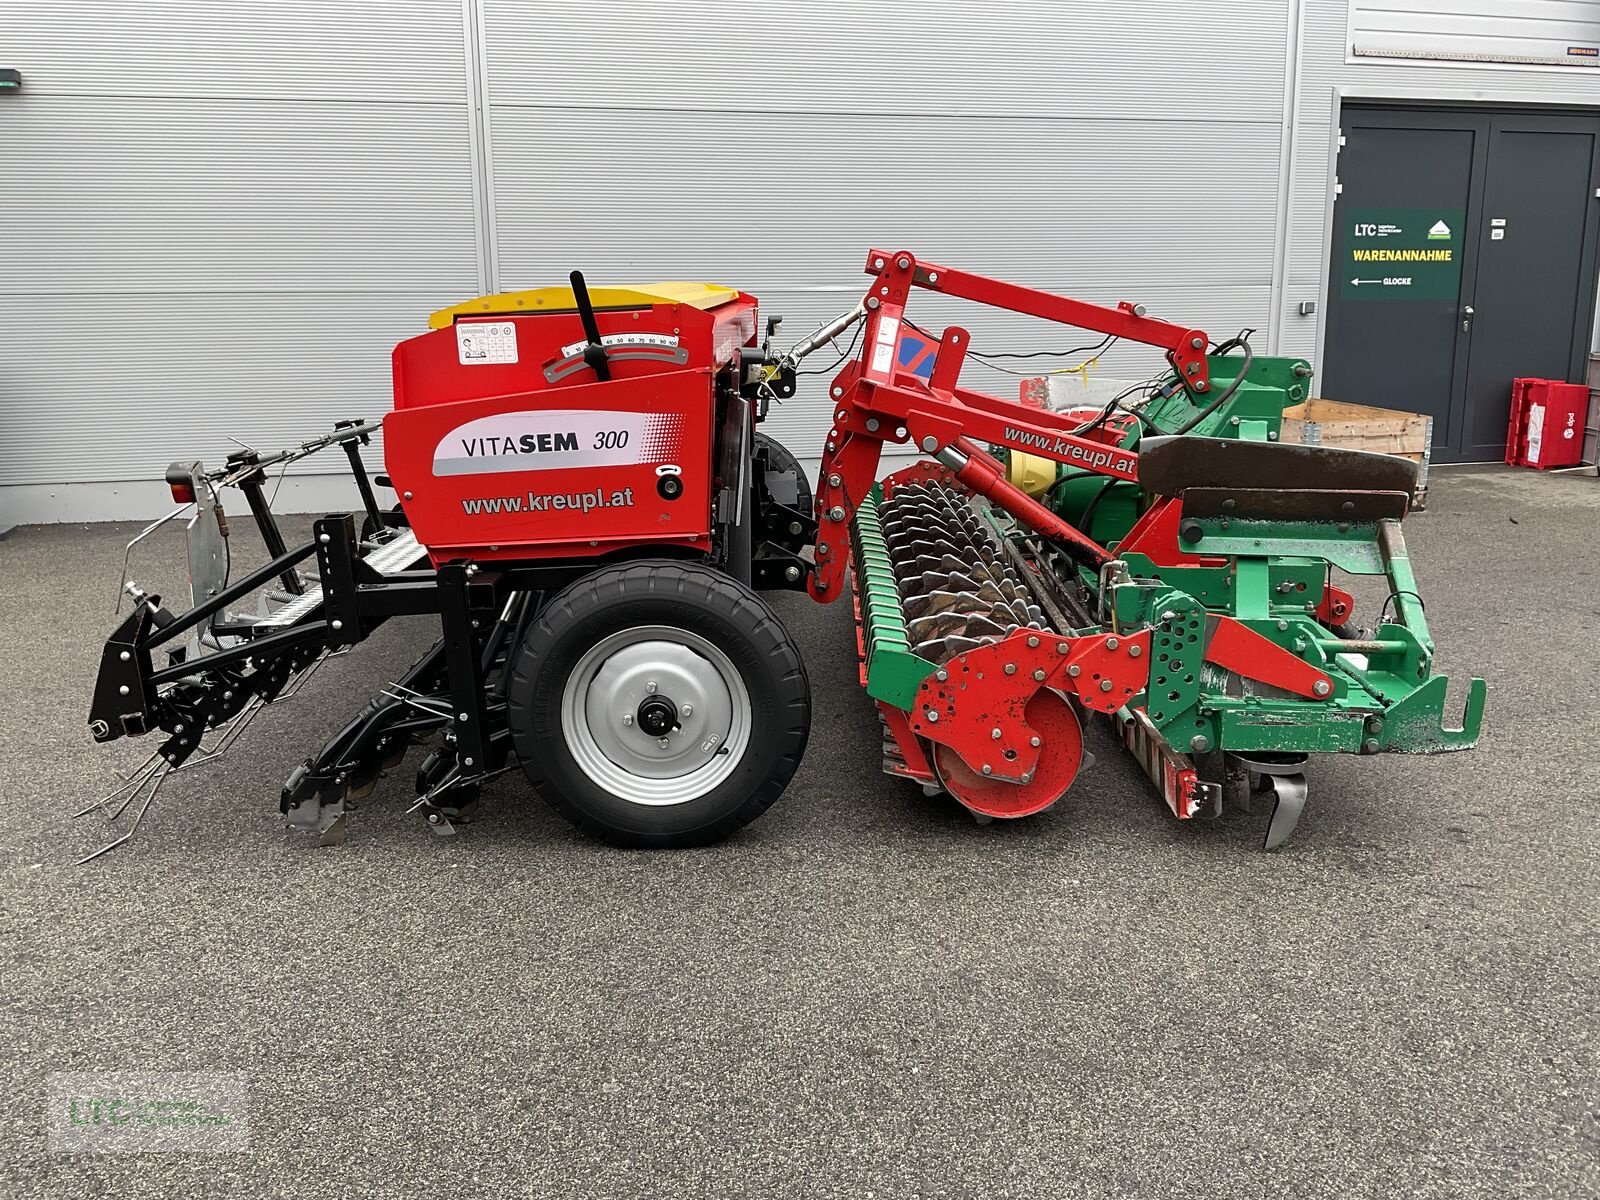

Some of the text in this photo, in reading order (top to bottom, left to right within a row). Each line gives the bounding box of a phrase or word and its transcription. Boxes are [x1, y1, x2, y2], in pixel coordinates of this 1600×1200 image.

[1354, 224, 1377, 236] LTC
[1353, 250, 1452, 261] WARENANNAHME
[1383, 277, 1412, 285] GLOCKE
[1567, 412, 1575, 427] dpd
[462, 430, 629, 457] VITASEM 300
[1004, 425, 1136, 474] www.kreupl.at
[462, 487, 634, 515] www.kreupl.at
